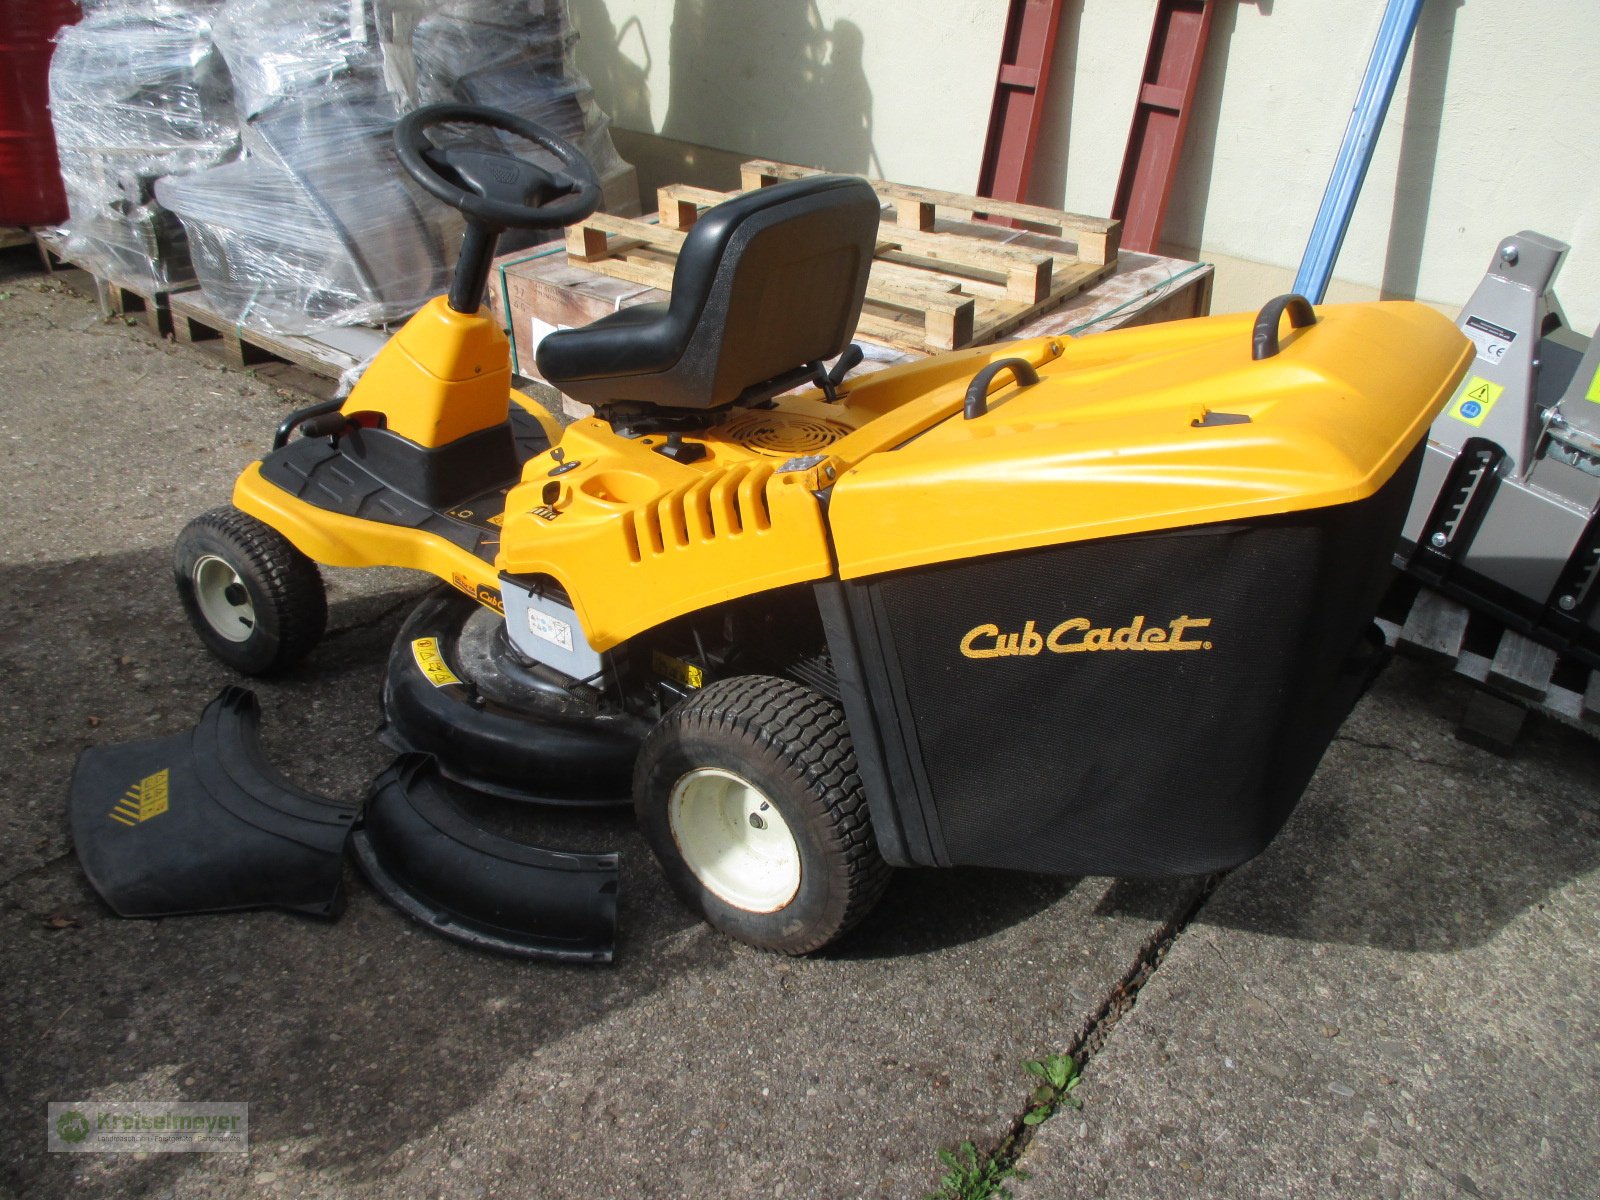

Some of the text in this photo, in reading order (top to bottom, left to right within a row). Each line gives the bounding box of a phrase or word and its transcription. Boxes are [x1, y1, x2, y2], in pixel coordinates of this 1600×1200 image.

[480, 591, 497, 606] Cub
[960, 615, 1211, 659] Cub Cadet
